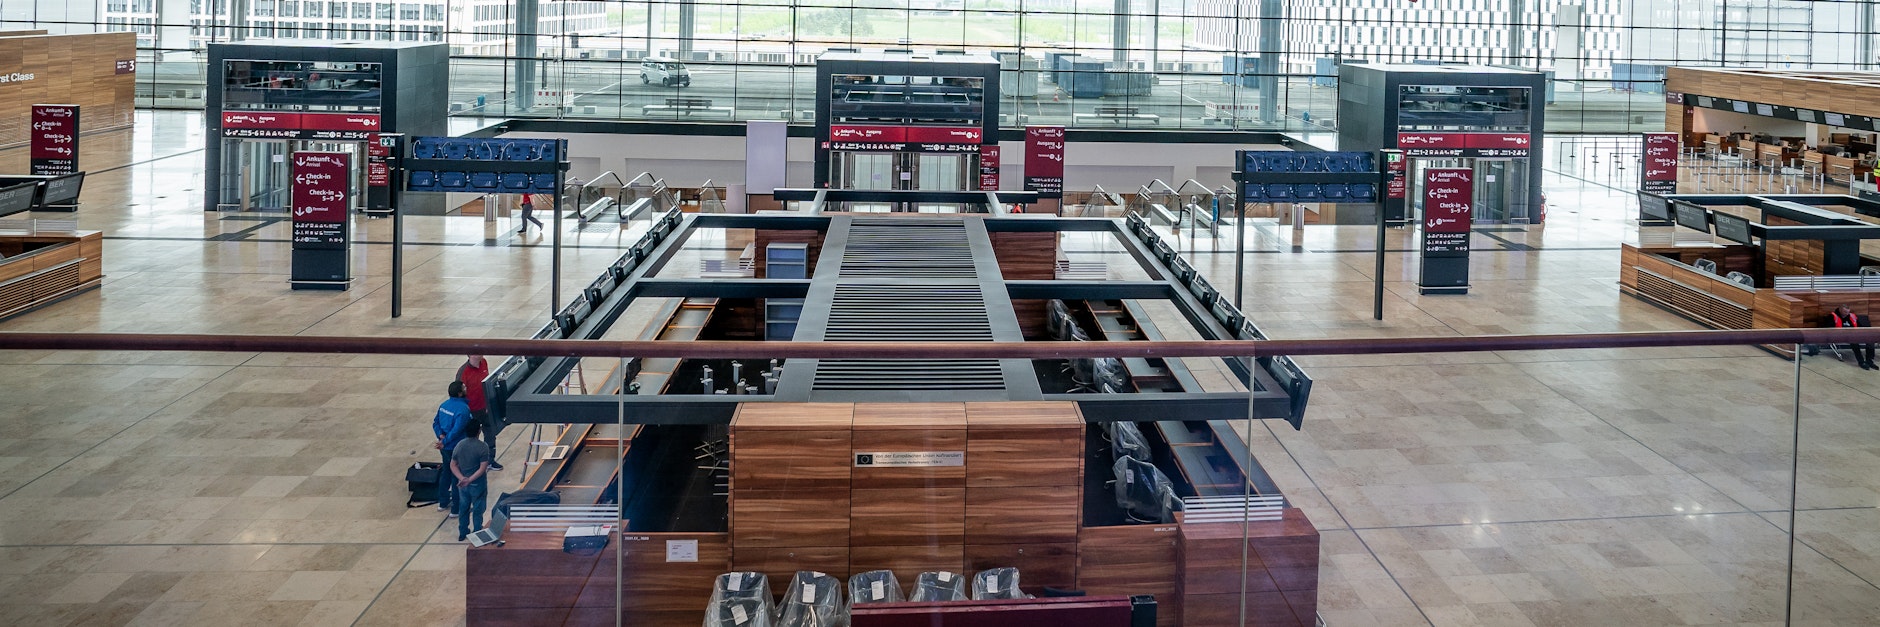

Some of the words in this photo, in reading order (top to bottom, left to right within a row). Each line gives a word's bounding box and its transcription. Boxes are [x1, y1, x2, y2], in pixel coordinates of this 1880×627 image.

[128, 60, 135, 71] 3
[10, 72, 35, 82] Class
[1677, 93, 1683, 103] 5
[1717, 214, 1731, 225] BER
